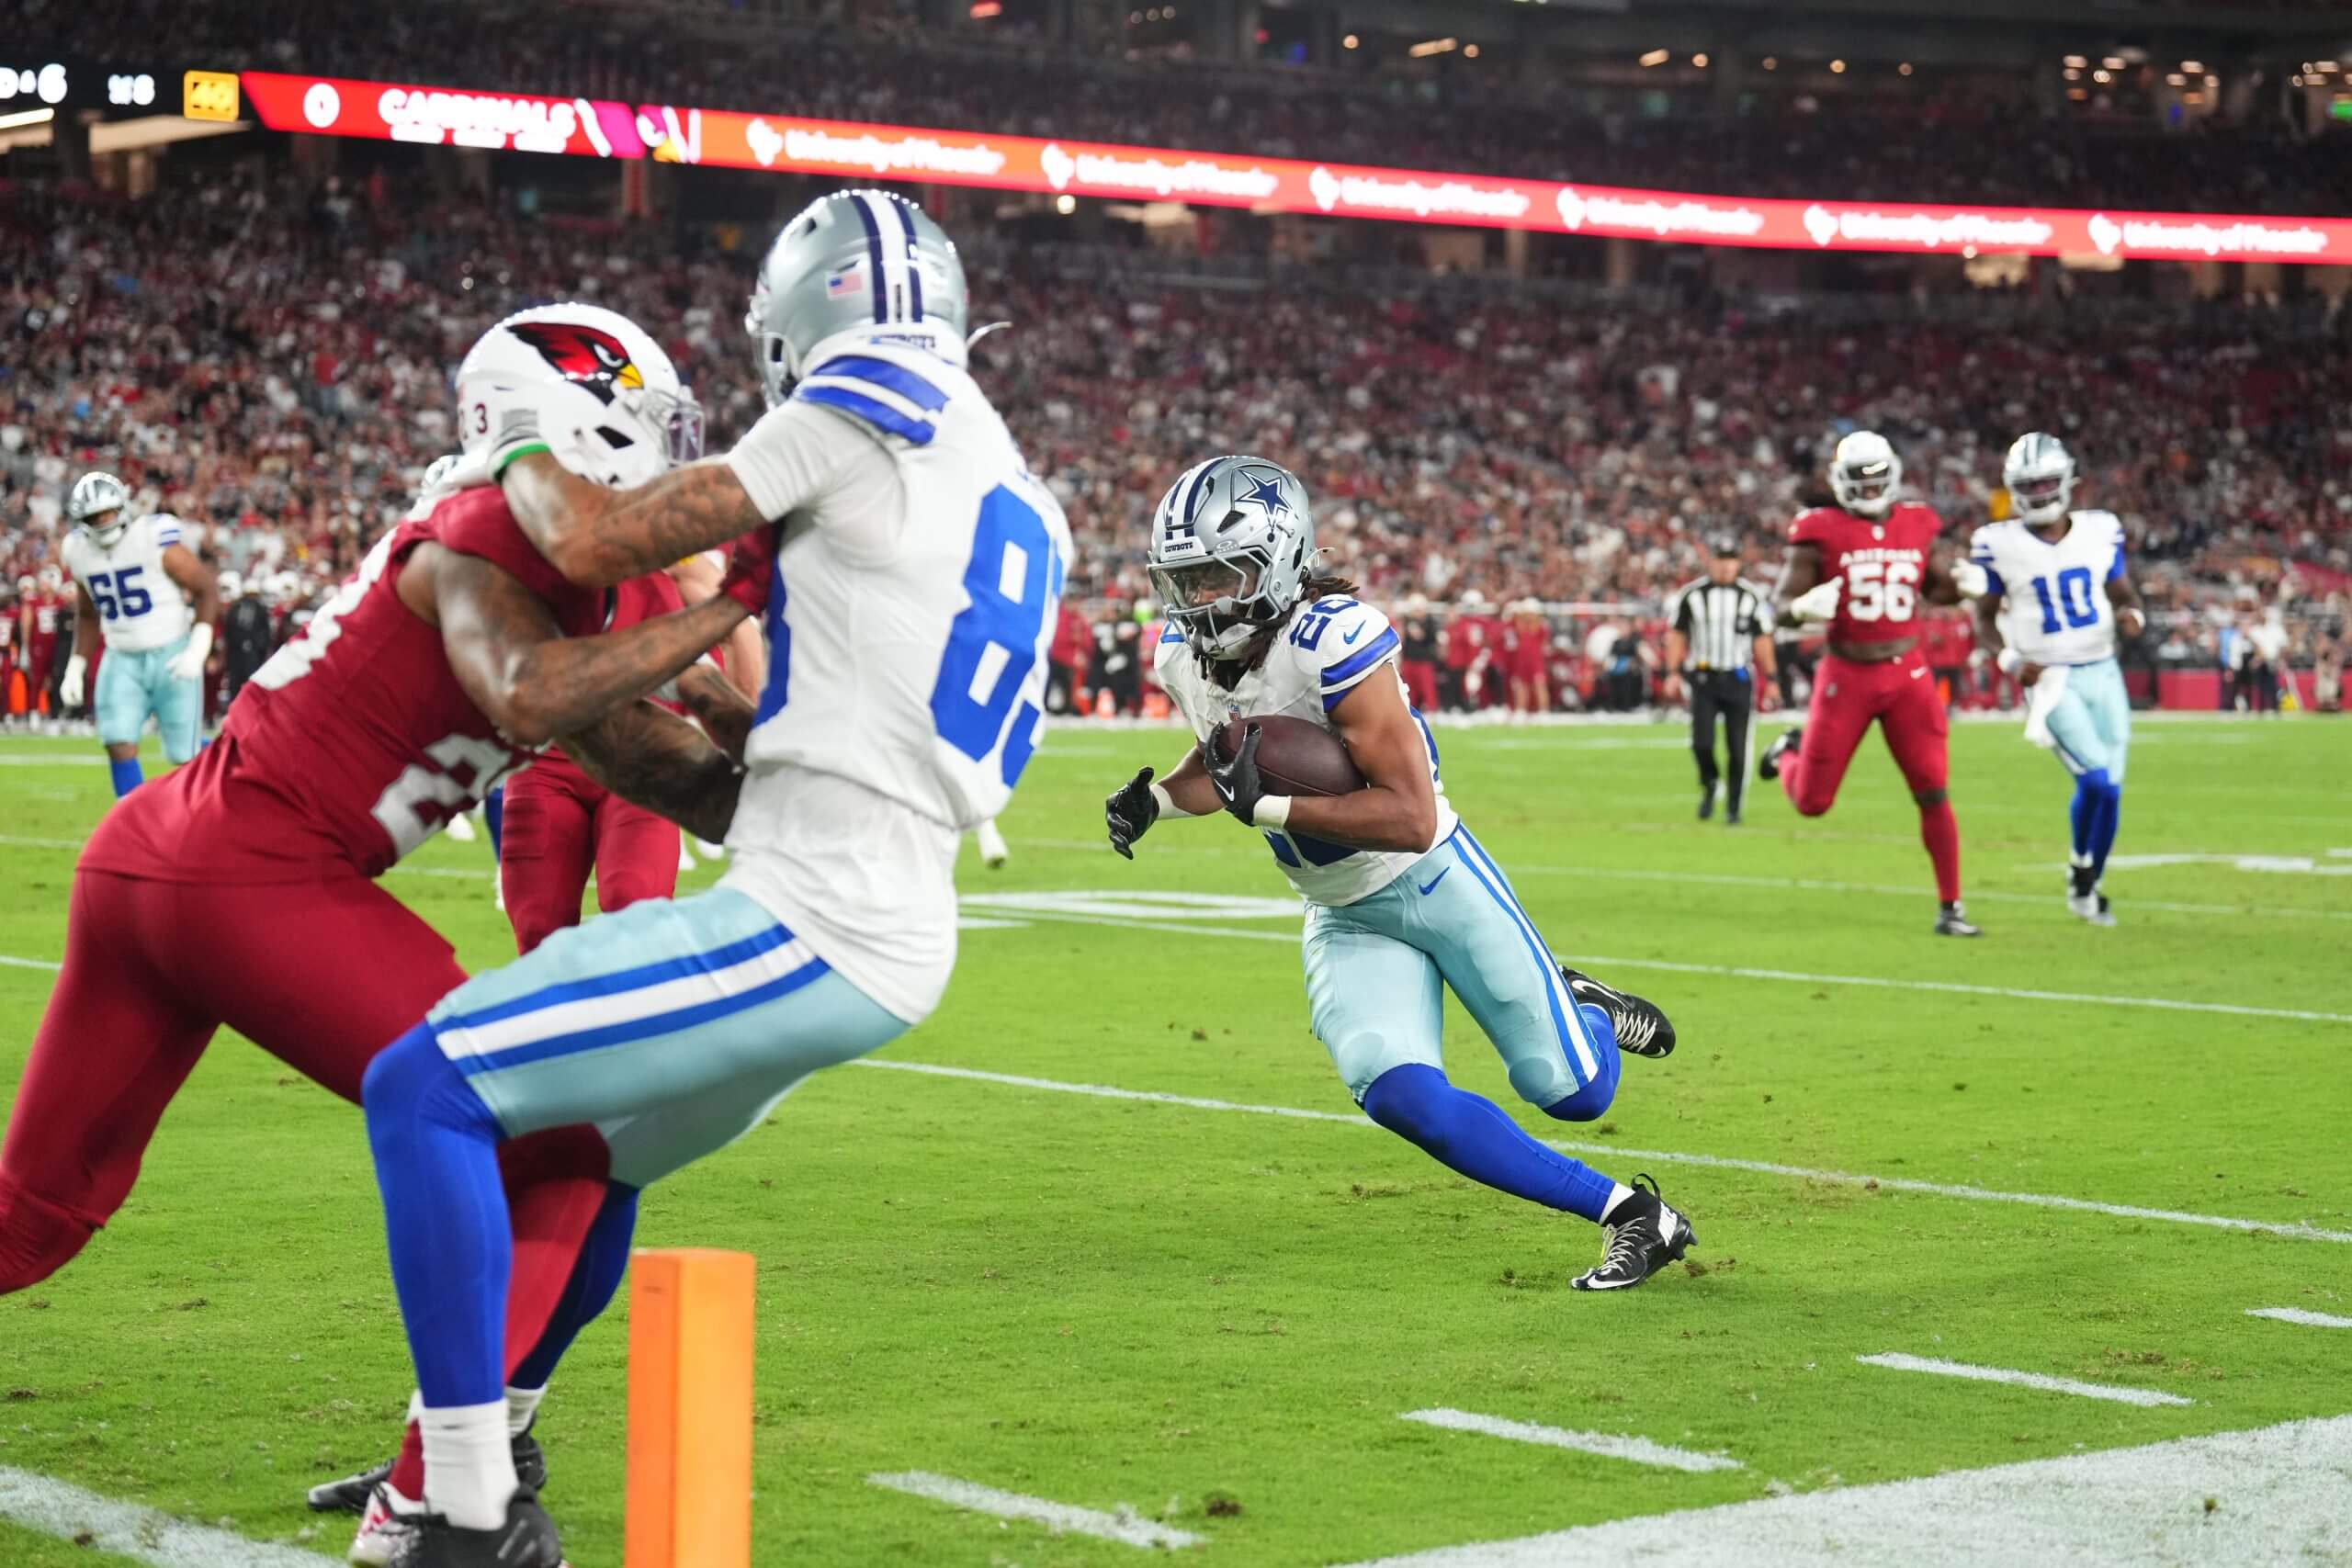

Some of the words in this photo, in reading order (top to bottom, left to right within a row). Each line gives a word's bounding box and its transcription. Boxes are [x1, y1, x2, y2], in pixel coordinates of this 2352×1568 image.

[1164, 542, 1193, 553] COWBOYS
[1839, 548, 1923, 569] ARIZONA
[1848, 562, 1918, 622] 56
[2031, 567, 2098, 634] 10
[1289, 599, 1360, 652] 20
